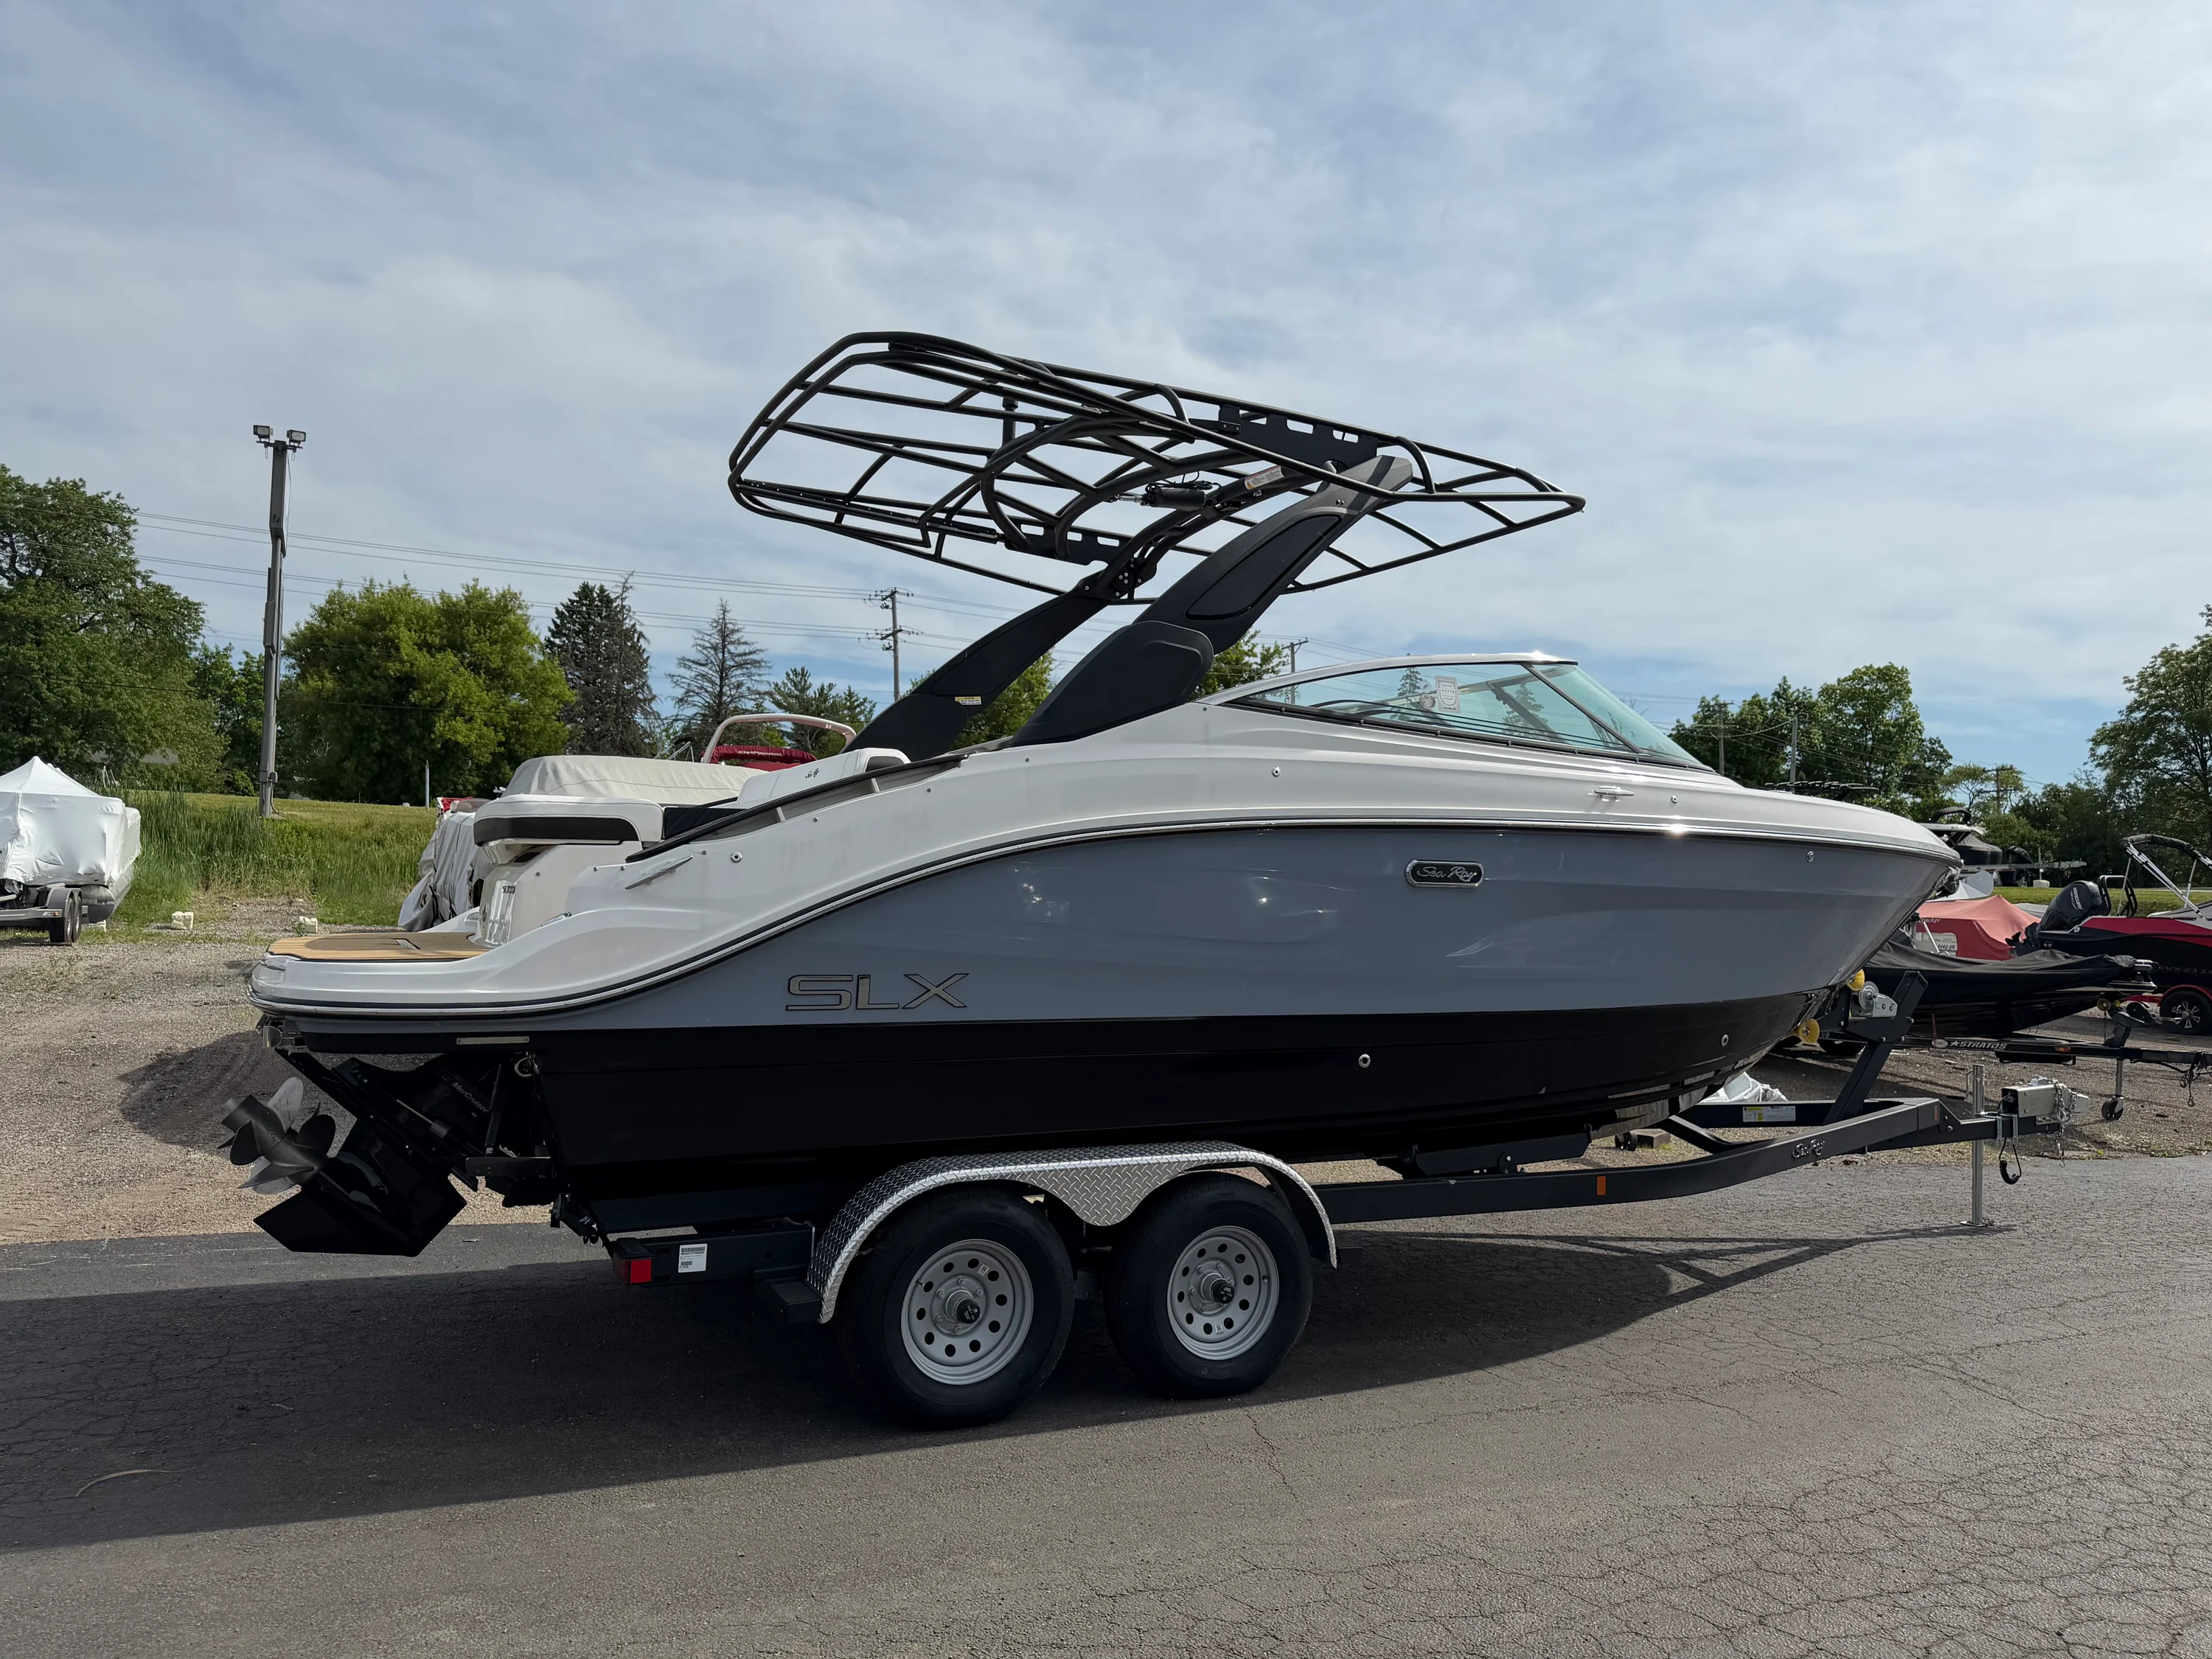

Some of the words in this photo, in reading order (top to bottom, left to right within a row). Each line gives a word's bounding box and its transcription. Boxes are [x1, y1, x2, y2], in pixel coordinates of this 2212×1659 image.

[1416, 866, 1447, 877] Sea
[1447, 866, 1477, 883] Ray
[2073, 887, 2083, 910] MERCURY
[785, 973, 970, 1011] SLX
[1959, 1041, 2008, 1049] STRATOS
[451, 1082, 490, 1113] MerCruiser
